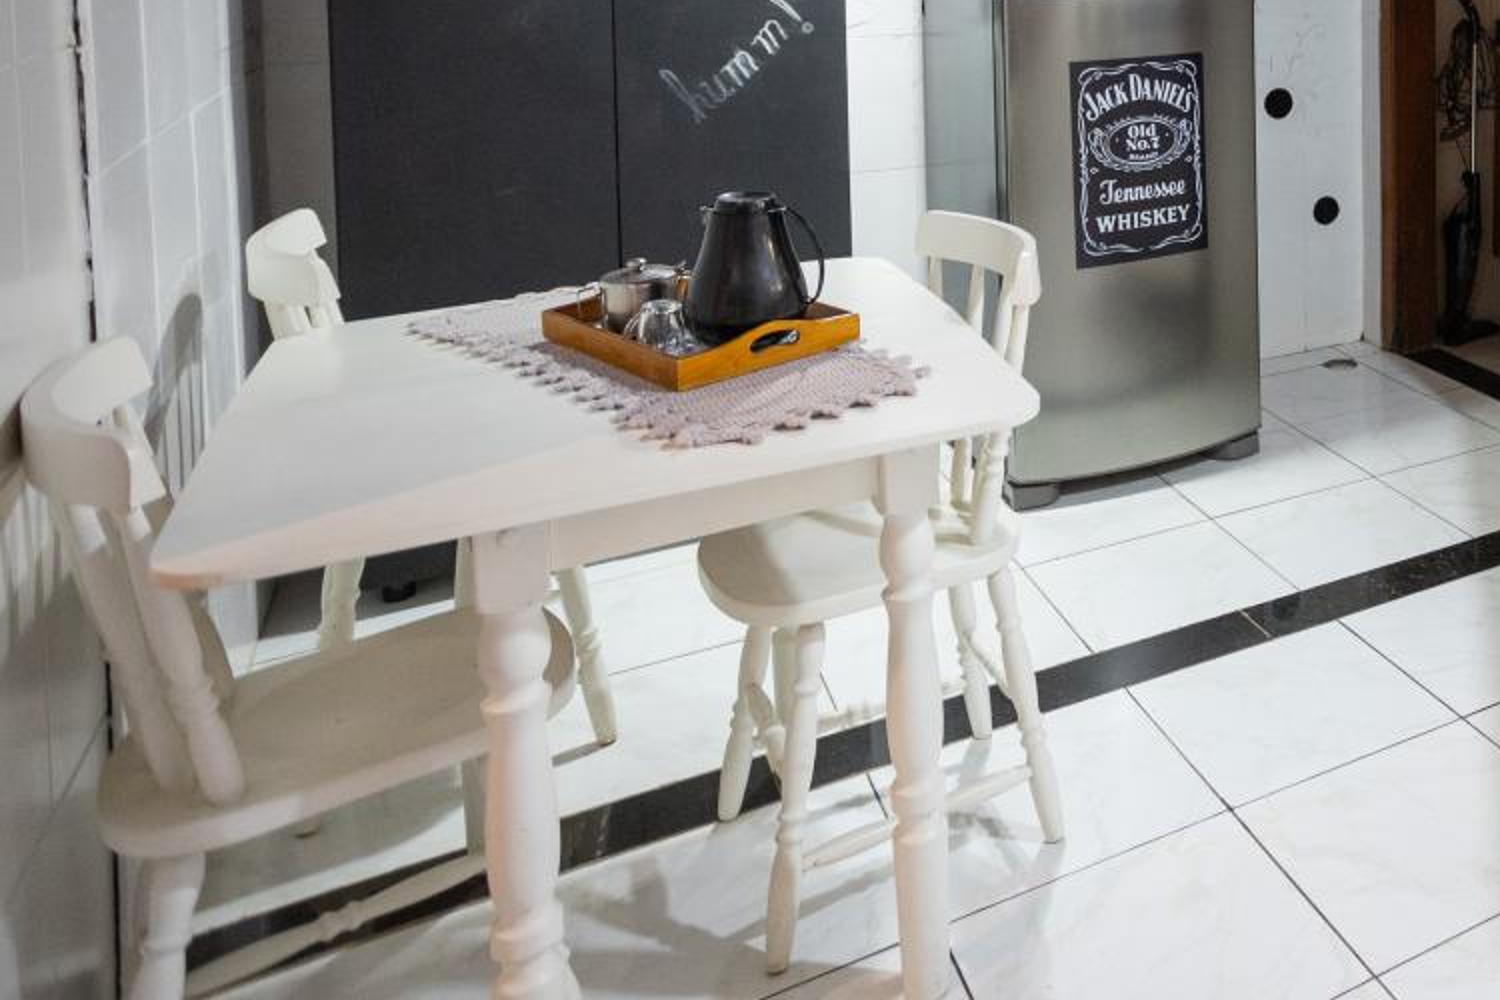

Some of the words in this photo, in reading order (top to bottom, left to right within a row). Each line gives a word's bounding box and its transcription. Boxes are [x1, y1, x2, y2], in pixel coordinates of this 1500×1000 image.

[1085, 81, 1129, 121] JACK
[1128, 73, 1192, 113] DANIEL'S
[1127, 123, 1157, 139] Old
[1100, 179, 1185, 205] Tennessee
[1096, 203, 1190, 233] WHISKEY
